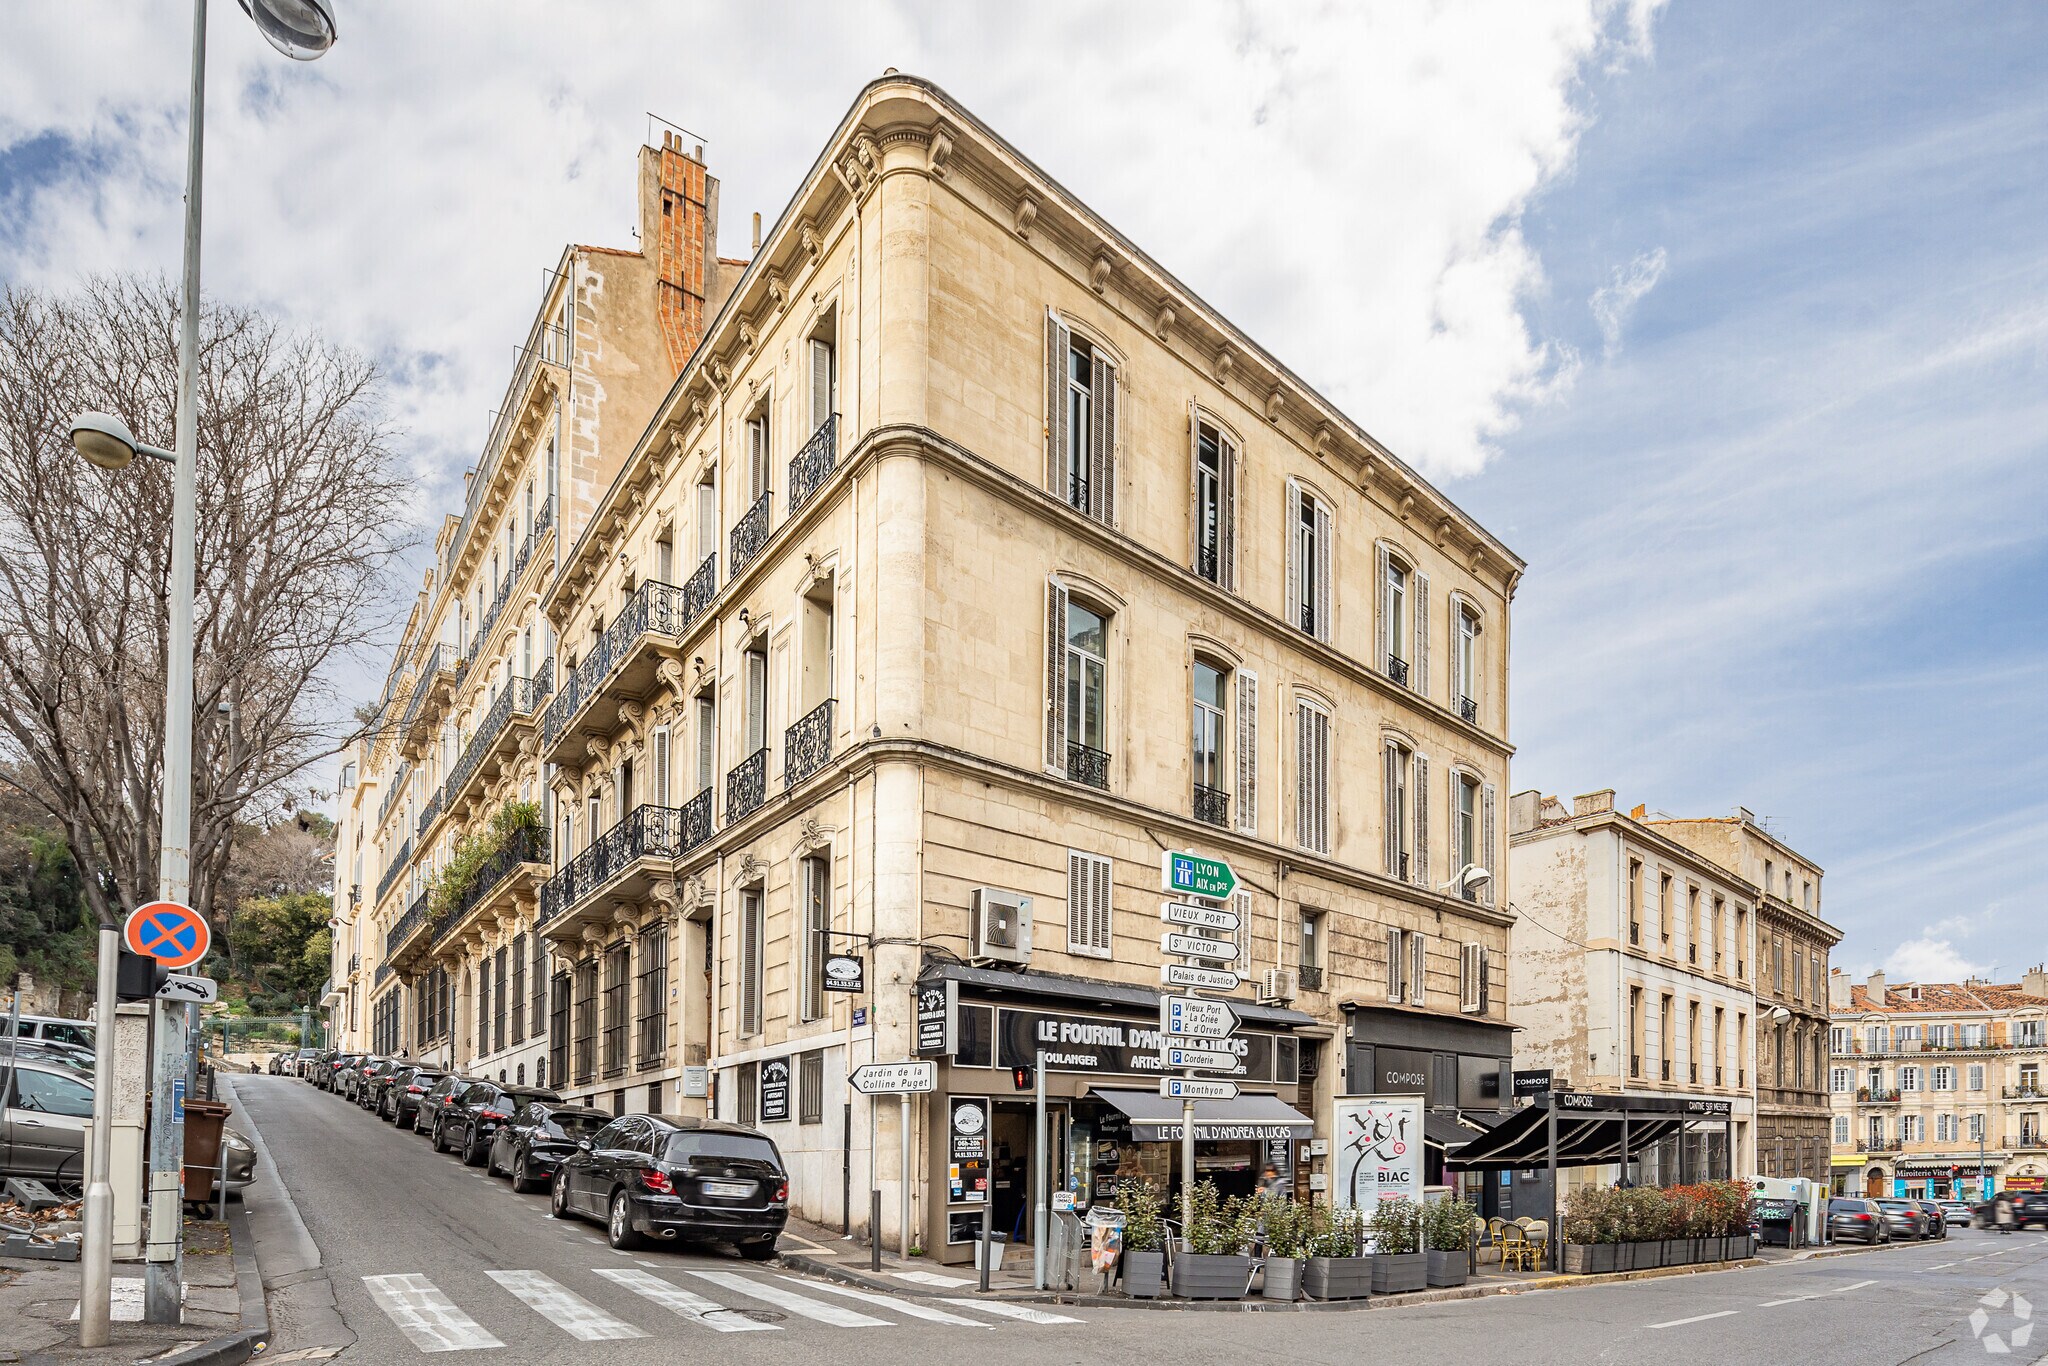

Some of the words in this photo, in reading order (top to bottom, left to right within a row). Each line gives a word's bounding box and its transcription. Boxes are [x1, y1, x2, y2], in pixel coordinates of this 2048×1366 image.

[1196, 862, 1219, 878] LYON
[1196, 878, 1208, 890] AIX
[1174, 908, 1199, 920] VIEUX
[1204, 913, 1226, 924] PORT
[1187, 941, 1218, 954] VICTOR
[1172, 970, 1194, 981] Palais
[1197, 973, 1206, 982] de
[1208, 974, 1234, 986] Justice
[922, 990, 945, 1006] FOURNIL
[1173, 1004, 1180, 1015] P
[1185, 1002, 1204, 1013] Vieux
[1206, 1005, 1221, 1014] Port
[1190, 1013, 1198, 1022] La
[1200, 1014, 1218, 1024] Criée
[1038, 1020, 1058, 1041] LE
[1060, 1022, 1126, 1046] FOURNIL
[1173, 1020, 1180, 1030] P
[1184, 1023, 1190, 1032] E.
[1194, 1025, 1220, 1034] d'Orves
[1045, 1052, 1098, 1066] OULANGER
[1131, 1056, 1173, 1070] ARTIS
[1174, 1052, 1180, 1062] P
[1184, 1054, 1213, 1064] Corderie
[762, 1069, 769, 1080] LE
[768, 1062, 788, 1077] FOURNIL
[864, 1069, 892, 1077] Jardin
[898, 1068, 908, 1076] de
[914, 1067, 922, 1075] la
[863, 1080, 895, 1088] Colline
[901, 1079, 927, 1089] Puget
[1386, 1072, 1424, 1085] COMPOSE
[1173, 1083, 1180, 1094] P
[1184, 1084, 1224, 1096] Monthyon
[1564, 1095, 1593, 1107] COMPOSE
[1158, 1126, 1168, 1139] LE
[1171, 1126, 1210, 1139] FORNIL
[1212, 1126, 1255, 1139] D'ANDREA
[1256, 1126, 1264, 1138] &
[1265, 1126, 1291, 1138] LUCAS
[1378, 1172, 1409, 1182] BIAC
